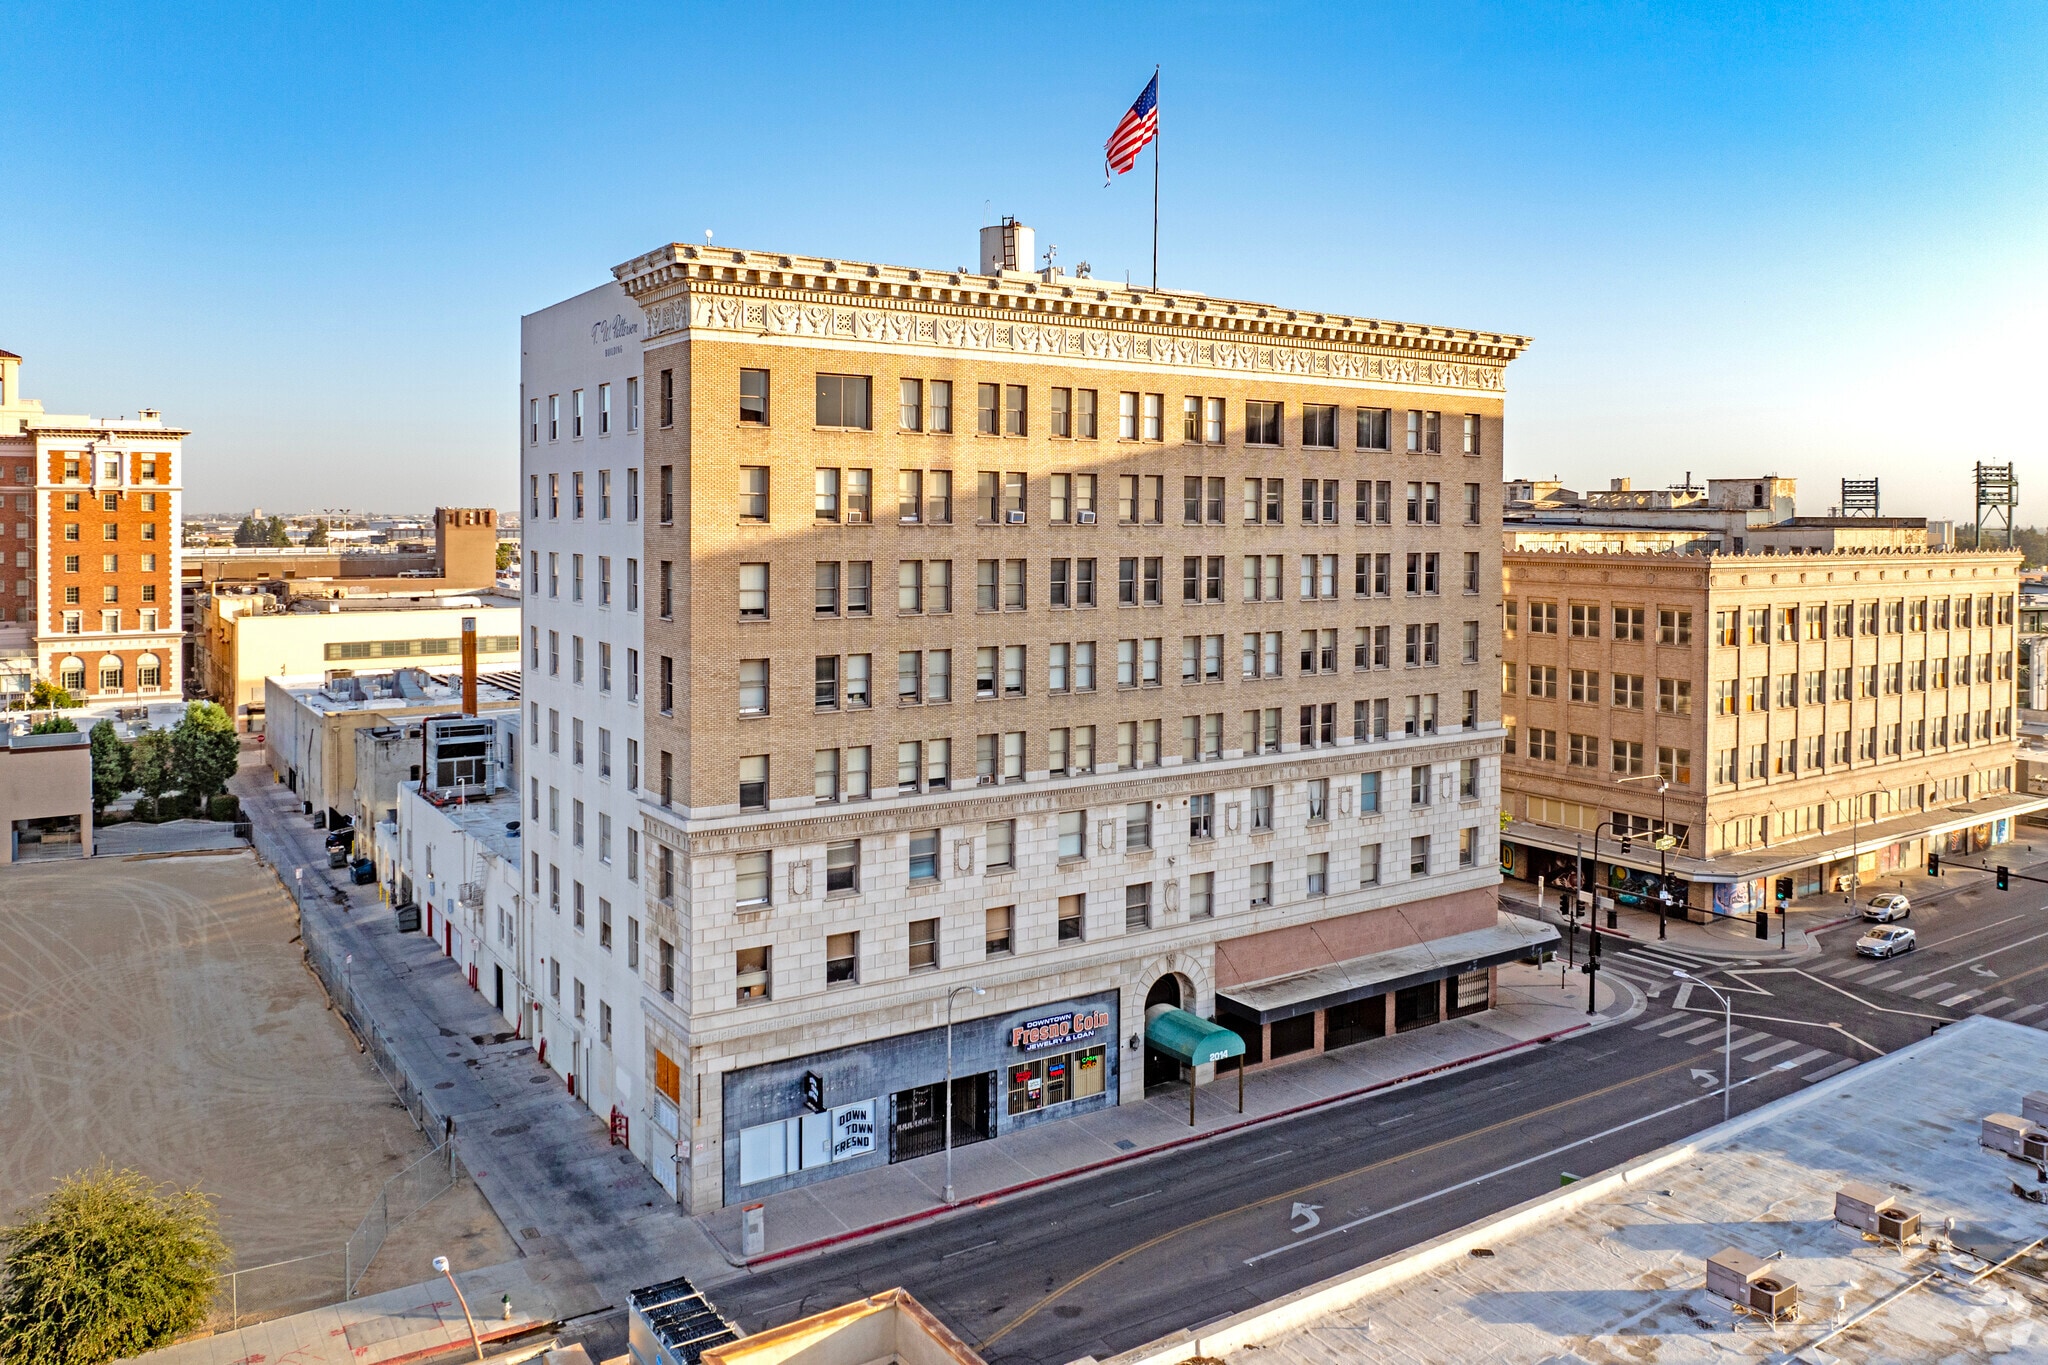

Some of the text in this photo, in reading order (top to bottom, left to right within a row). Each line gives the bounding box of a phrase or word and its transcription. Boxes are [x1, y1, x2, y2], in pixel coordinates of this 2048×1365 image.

[1012, 1010, 1109, 1047] Fresno Coin
[1026, 1013, 1072, 1029] DOWNTOWN
[1026, 1037, 1064, 1051] JEWELRY
[1072, 1030, 1095, 1040] LOAN
[1081, 1055, 1098, 1063] CASH
[1209, 1049, 1228, 1062] 2014
[1081, 1062, 1097, 1070] GOLD
[839, 1110, 867, 1126] DOWN
[846, 1123, 873, 1135] TOWN
[834, 1136, 870, 1155] FRESNO
